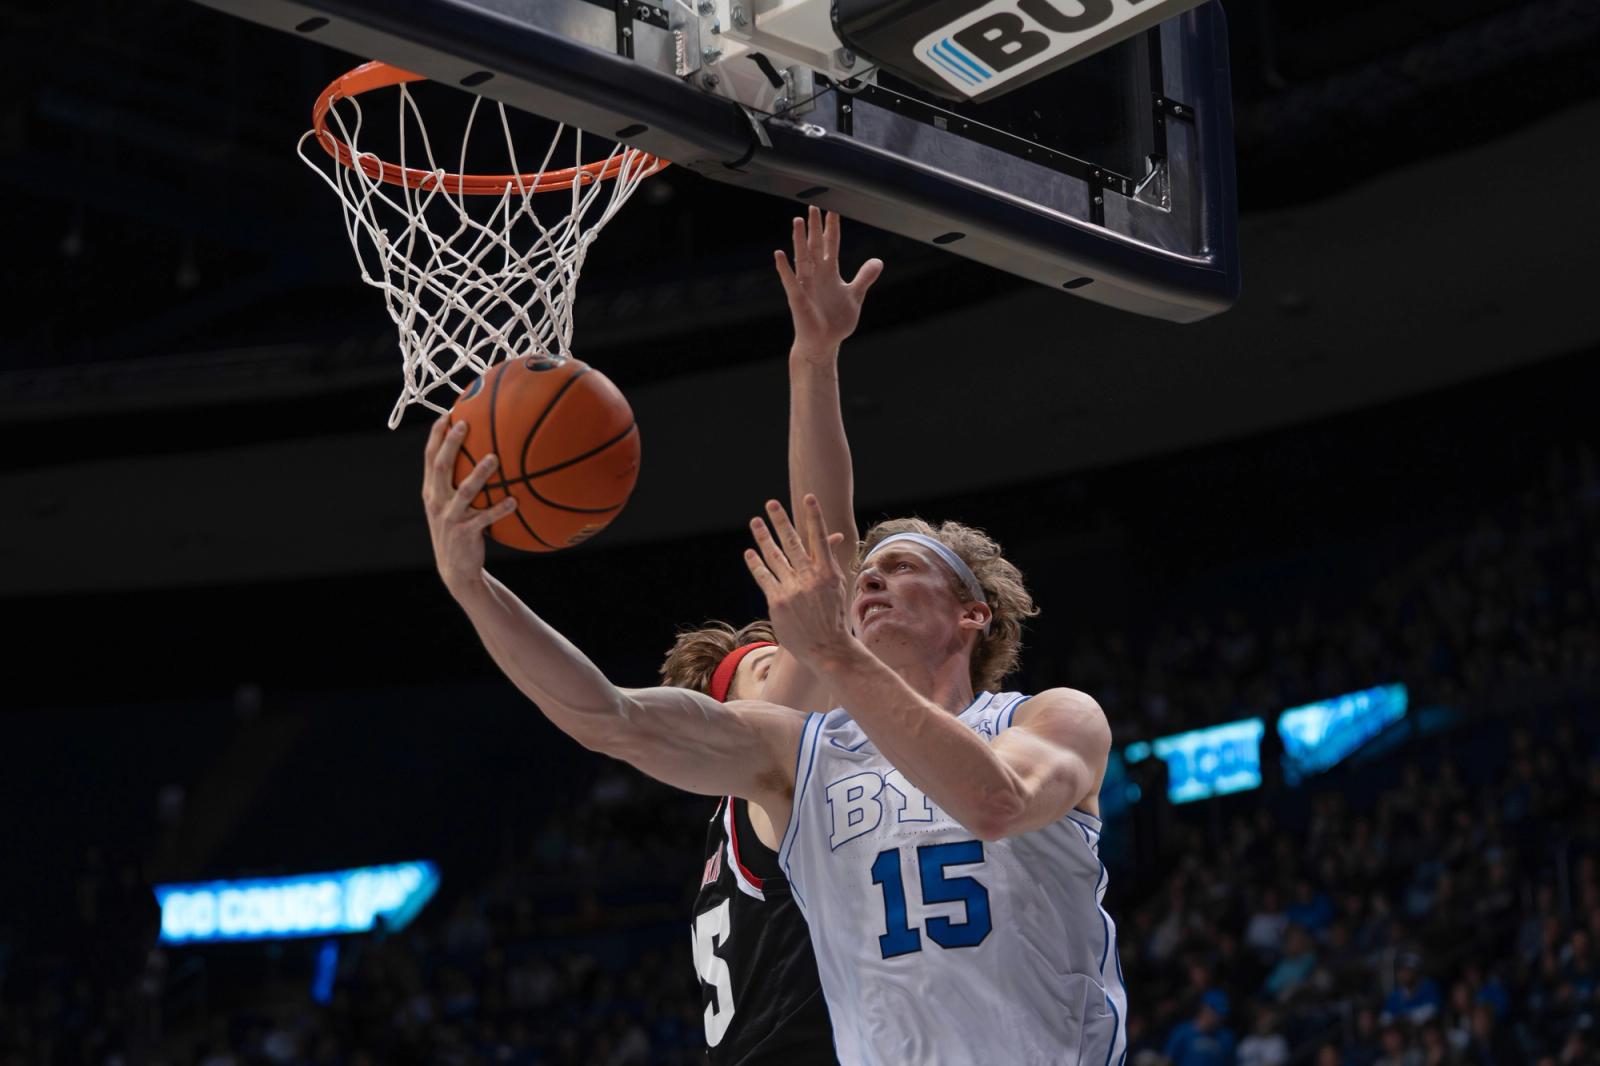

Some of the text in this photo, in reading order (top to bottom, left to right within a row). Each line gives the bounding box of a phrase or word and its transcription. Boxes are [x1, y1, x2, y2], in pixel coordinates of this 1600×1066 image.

[953, 0, 1146, 73] BU
[825, 769, 933, 853] BY
[870, 840, 992, 959] 15
[691, 898, 735, 1047] 5
